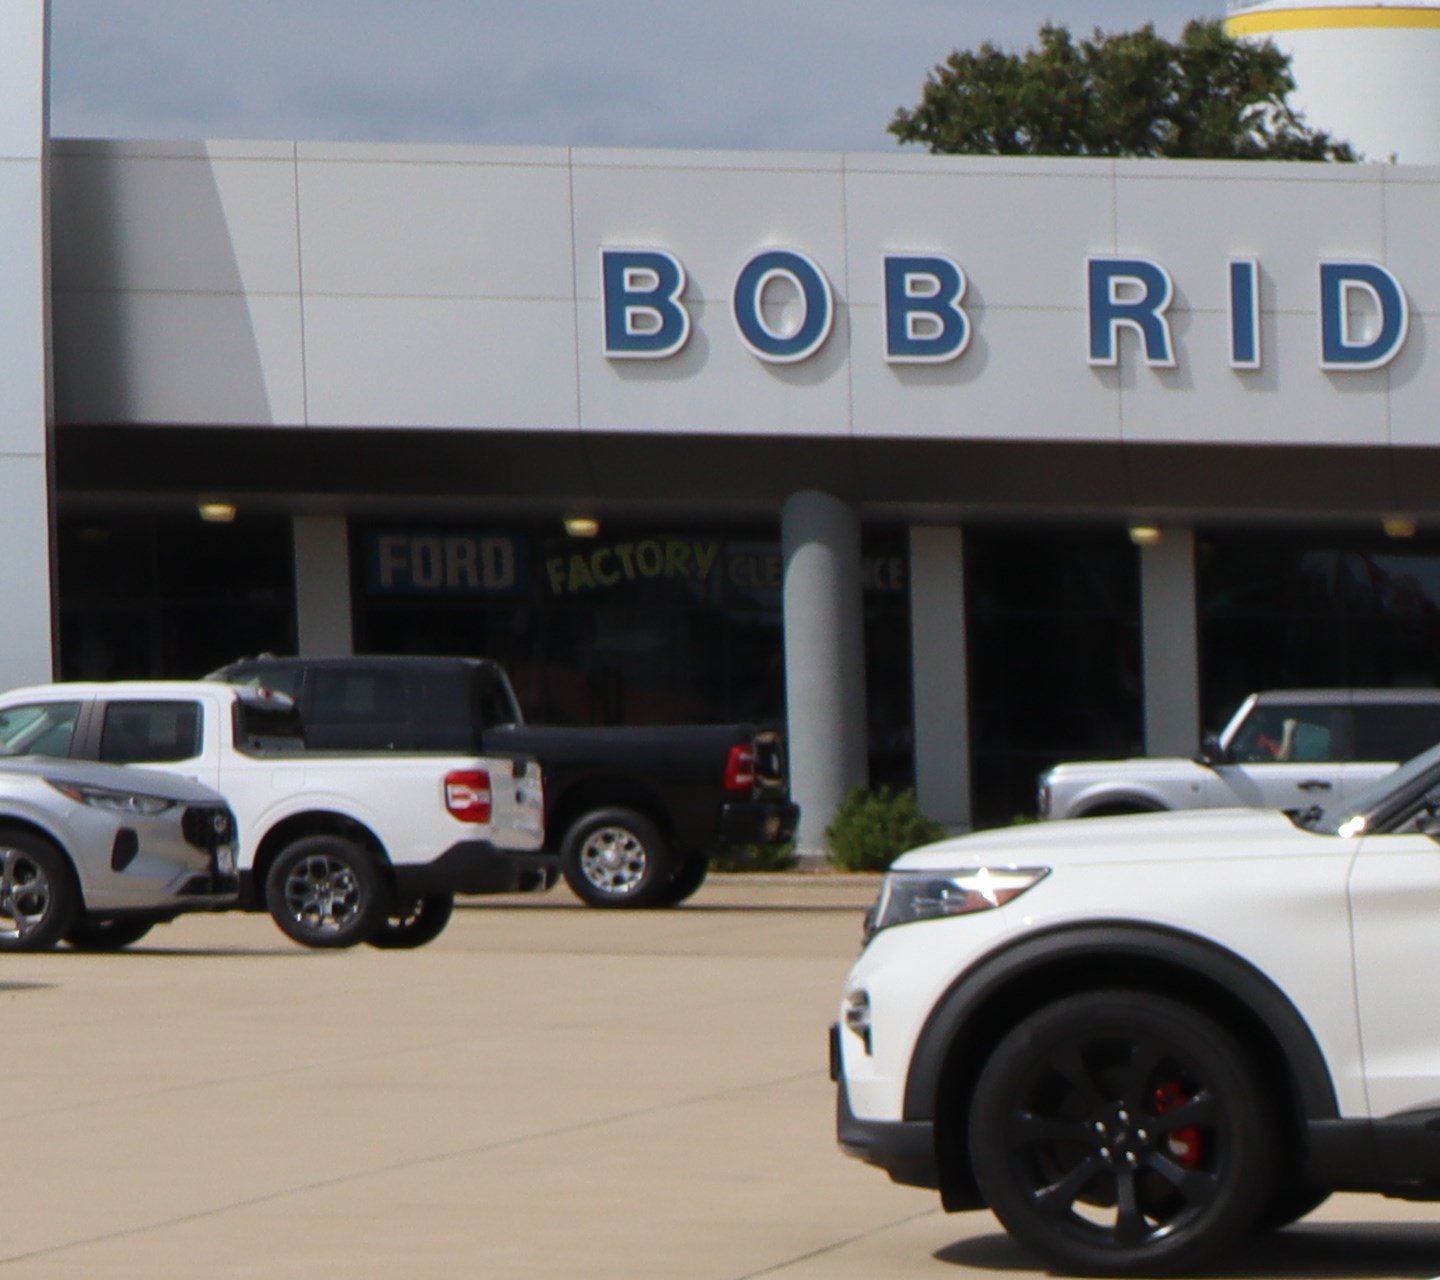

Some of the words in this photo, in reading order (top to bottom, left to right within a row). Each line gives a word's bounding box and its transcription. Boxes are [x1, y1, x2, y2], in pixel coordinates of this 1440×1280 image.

[599, 245, 971, 367] BOB
[377, 535, 516, 589] FORD
[545, 536, 720, 597] FACTORY
